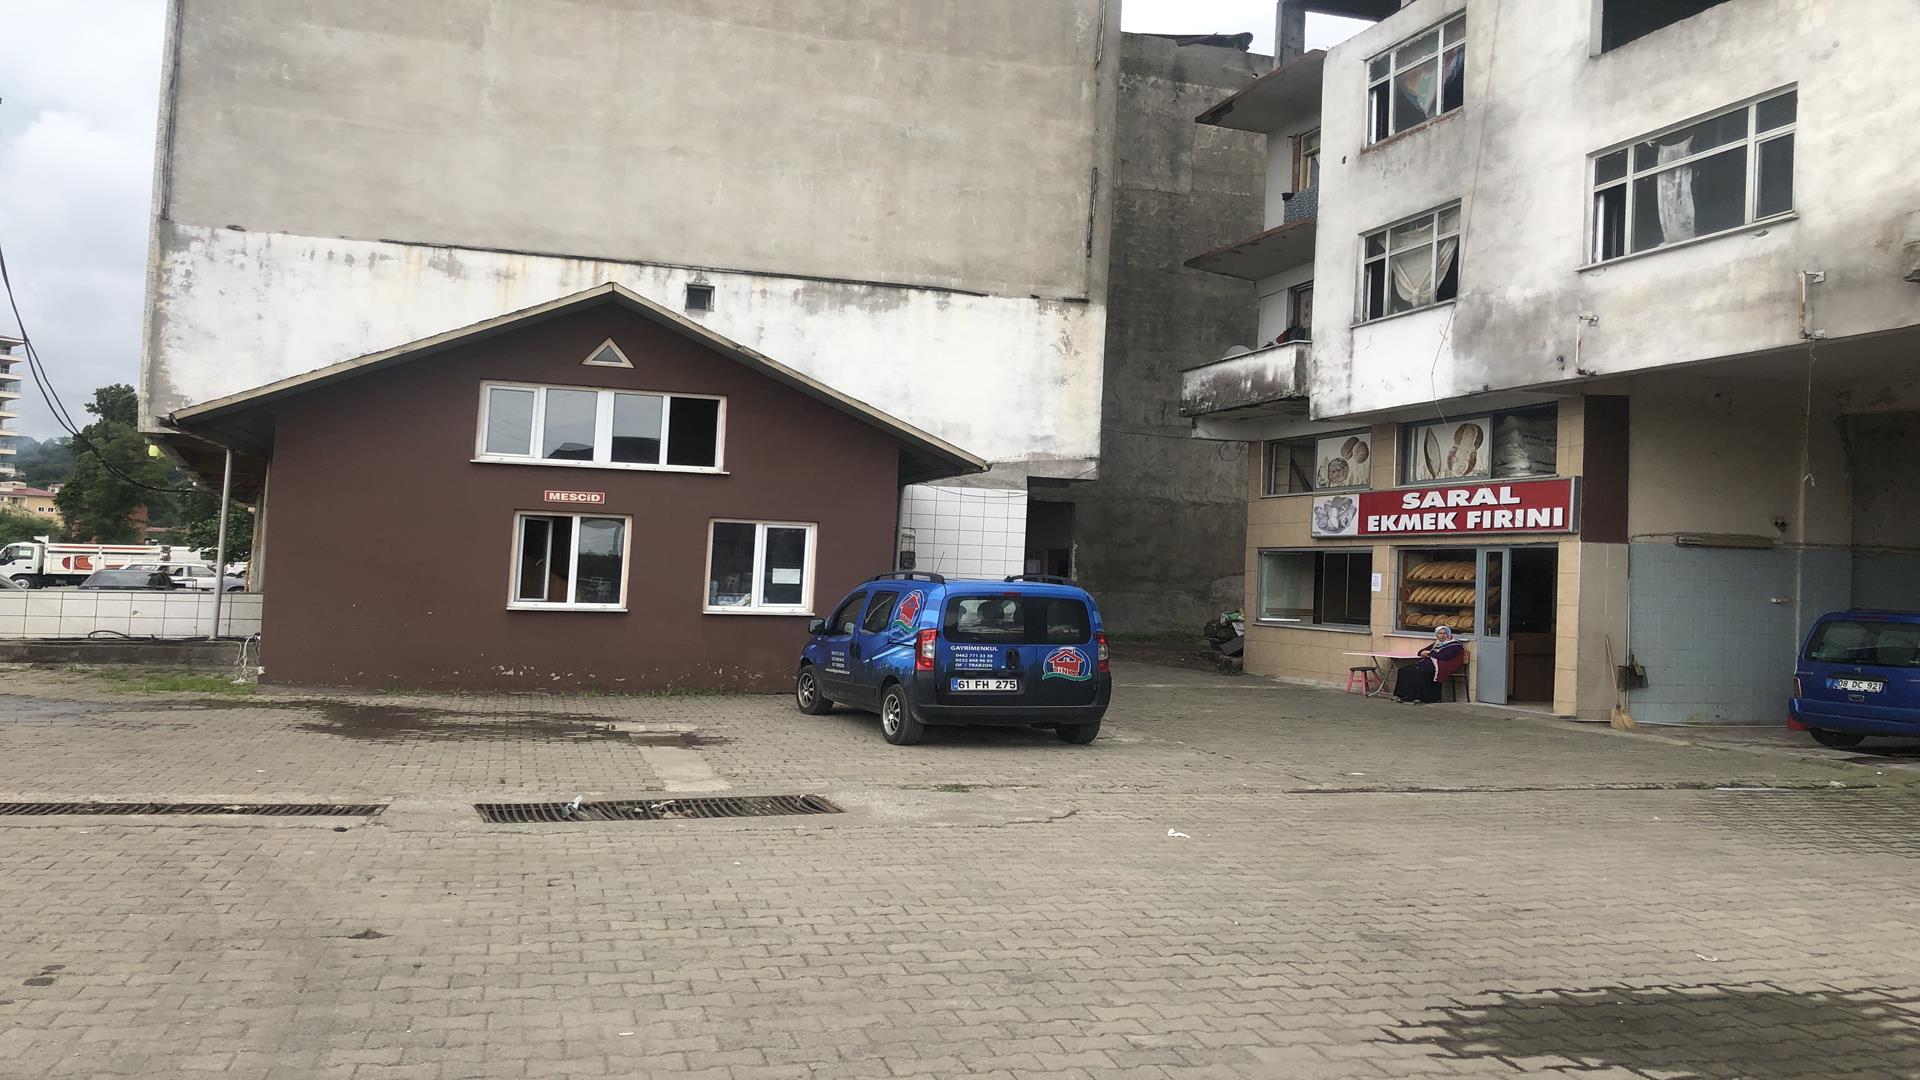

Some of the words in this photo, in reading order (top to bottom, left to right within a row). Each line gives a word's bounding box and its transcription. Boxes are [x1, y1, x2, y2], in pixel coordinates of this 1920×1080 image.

[1401, 486, 1521, 509] SARAL
[1366, 511, 1457, 532] EKMEK
[1466, 506, 1564, 529] FIRINI
[958, 680, 970, 689] 61
[975, 680, 989, 689] FH
[995, 680, 1016, 690] 275
[1851, 681, 1863, 689] DC
[1866, 682, 1882, 690] 921
